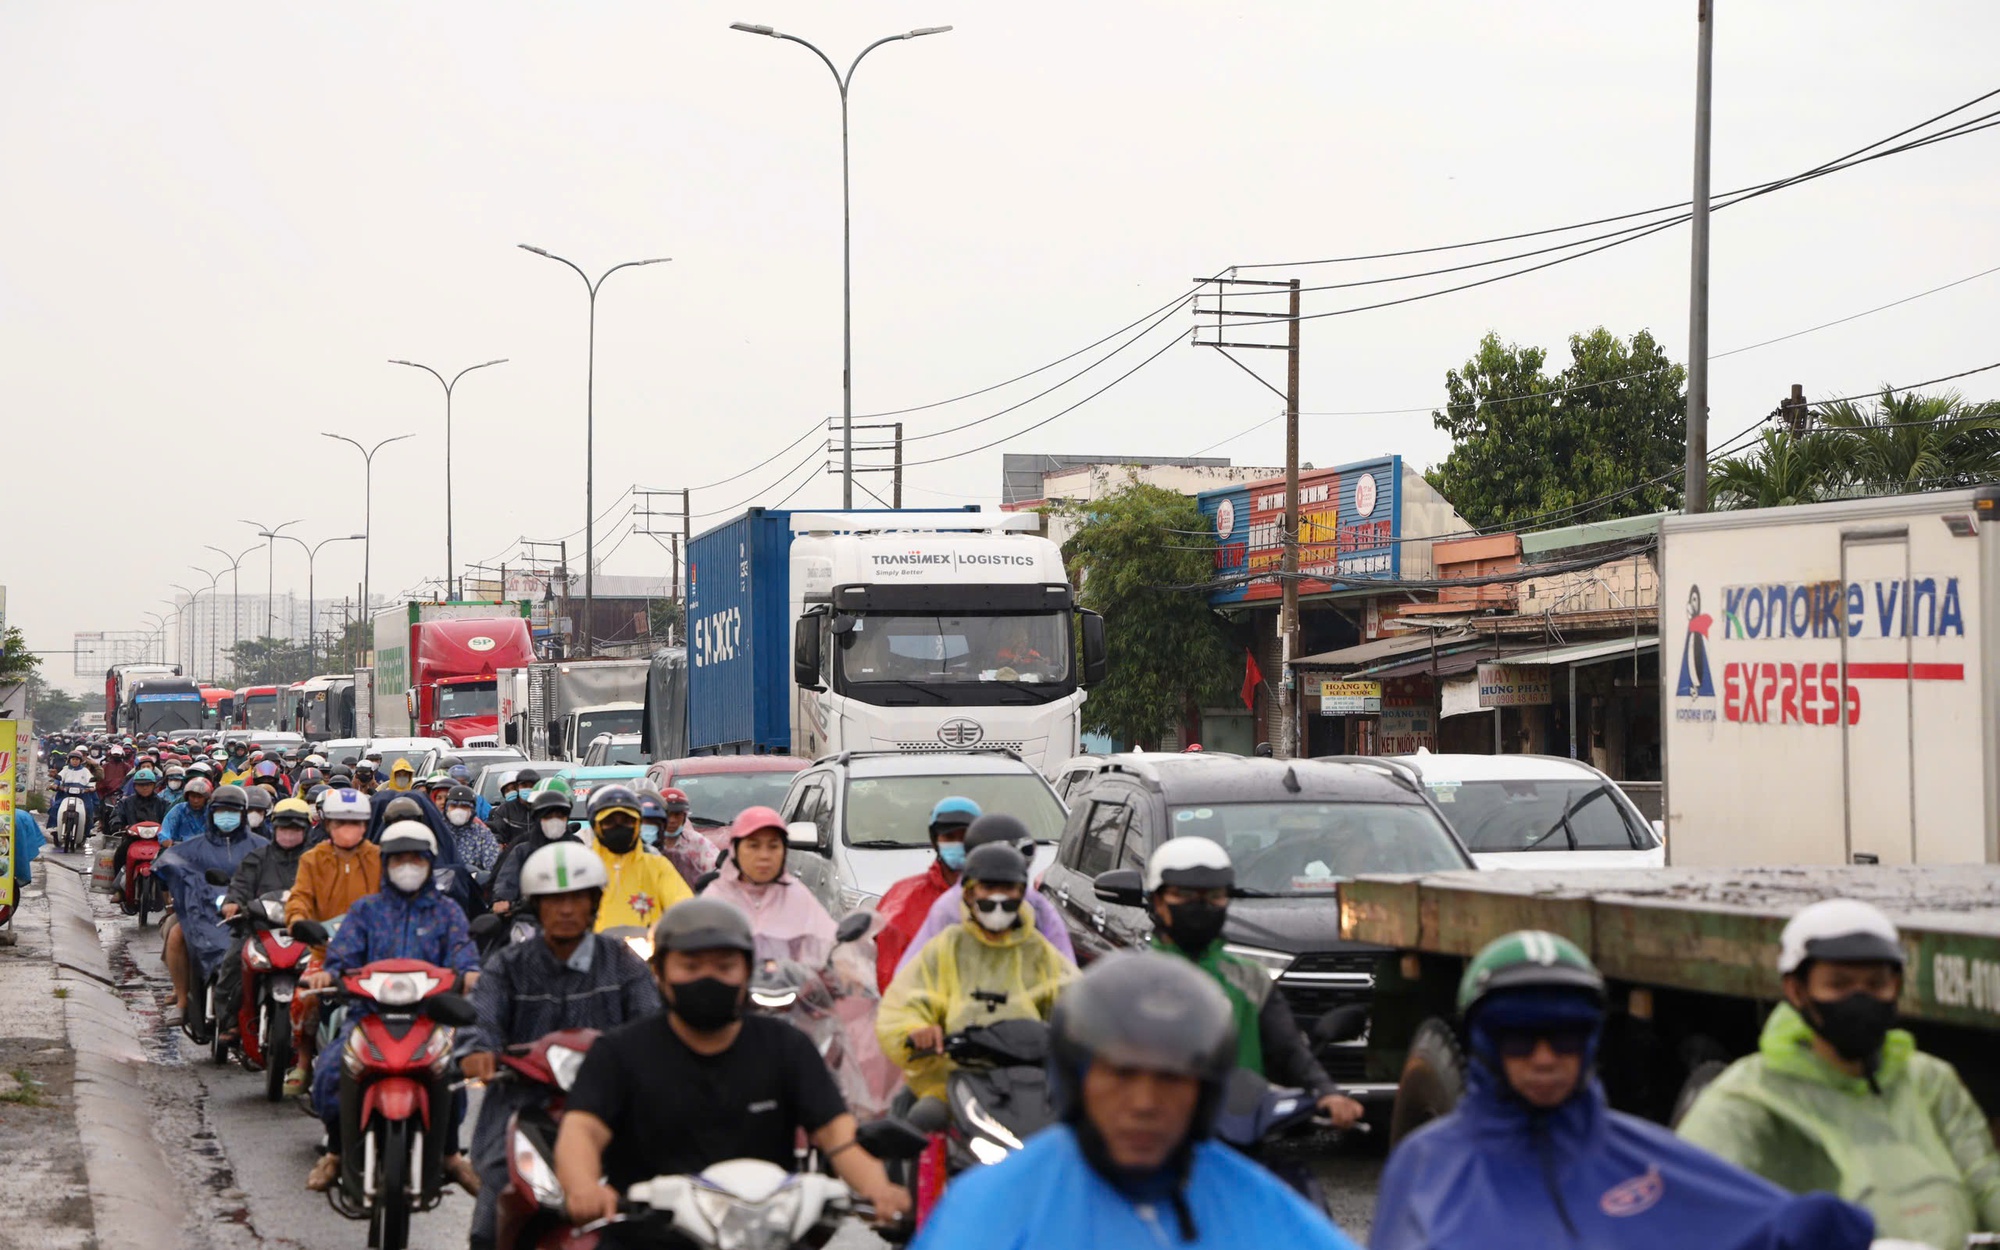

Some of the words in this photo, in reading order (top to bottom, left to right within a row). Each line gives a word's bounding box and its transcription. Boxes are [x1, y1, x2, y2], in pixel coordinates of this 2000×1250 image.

[871, 552, 950, 565] TRANSIMEX
[959, 555, 1034, 566] LOGISTICS
[1723, 662, 1861, 725] EXPRESS
[1381, 733, 1395, 754] KÉT
[1396, 732, 1416, 753] NƯỚC
